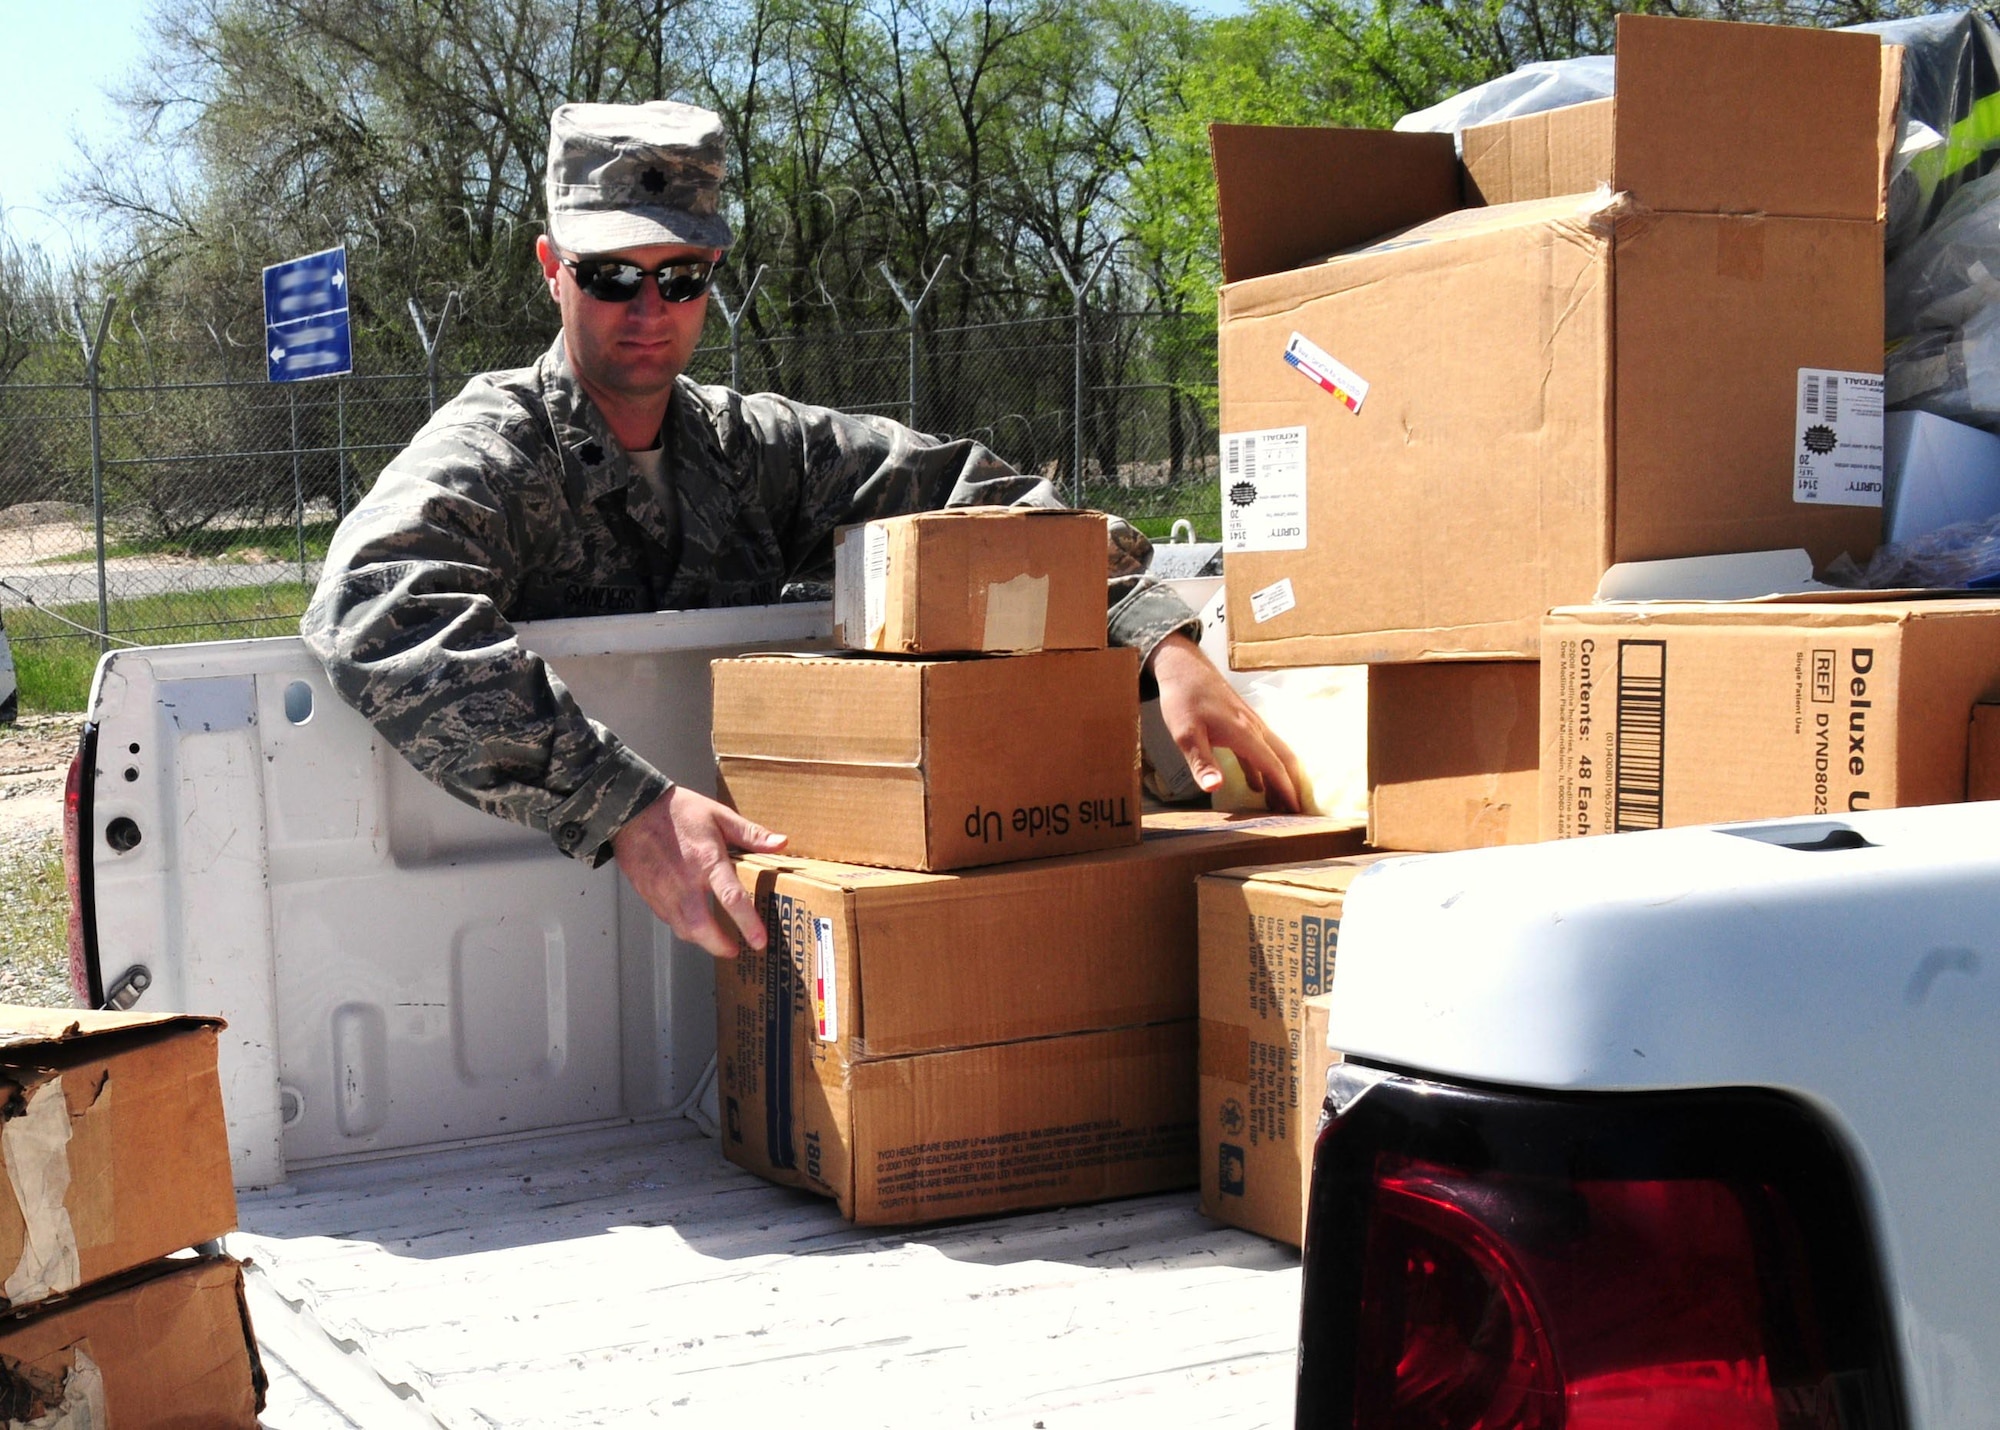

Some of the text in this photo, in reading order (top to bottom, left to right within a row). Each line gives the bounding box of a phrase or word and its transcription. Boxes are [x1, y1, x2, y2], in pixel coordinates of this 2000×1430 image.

[1799, 454, 1809, 465] 20
[1798, 480, 1818, 490] 3141
[1849, 482, 1882, 492] CURITY
[1230, 510, 1239, 519] 20
[1230, 531, 1247, 540] 3141
[1271, 527, 1300, 537] CURITY
[1560, 640, 1568, 659] One
[1795, 652, 1803, 681] Single
[1817, 658, 1830, 696] REF
[1795, 683, 1803, 714] Patient
[1849, 648, 1874, 776] Deluxe
[1578, 639, 1595, 836] Contents: 48 Each
[1566, 777, 1574, 812] Medline
[965, 797, 1132, 843] This Side Up
[1267, 917, 1275, 942] Gaze
[1277, 918, 1285, 940] USP
[1290, 921, 1299, 929] 8
[781, 902, 791, 994] CURITY
[1288, 933, 1298, 954] Ply
[1306, 923, 1319, 977] Gauze
[1249, 946, 1257, 968] USP
[1266, 945, 1275, 967] type
[1276, 943, 1285, 967] Type
[1289, 957, 1298, 982] 2in.
[1268, 987, 1277, 1009] USP
[1290, 987, 1297, 995] x
[1290, 998, 1299, 1023] 2in.
[1289, 1028, 1299, 1060] (5cm
[1268, 1045, 1276, 1067] USP
[1289, 1076, 1298, 1109] 5cm)
[1278, 1118, 1286, 1140] USP
[878, 1149, 895, 1160] TYCO
[896, 1142, 941, 1158] HEALTHCARE
[942, 1139, 970, 1151] GROUP
[903, 1157, 921, 1169] TYCO
[922, 1151, 969, 1166] HEALTHCARE
[970, 1148, 998, 1159] GROUP
[976, 1160, 995, 1171] TYCO
[878, 1185, 895, 1196] TYCO
[895, 1179, 941, 1194] HEALTHCARE
